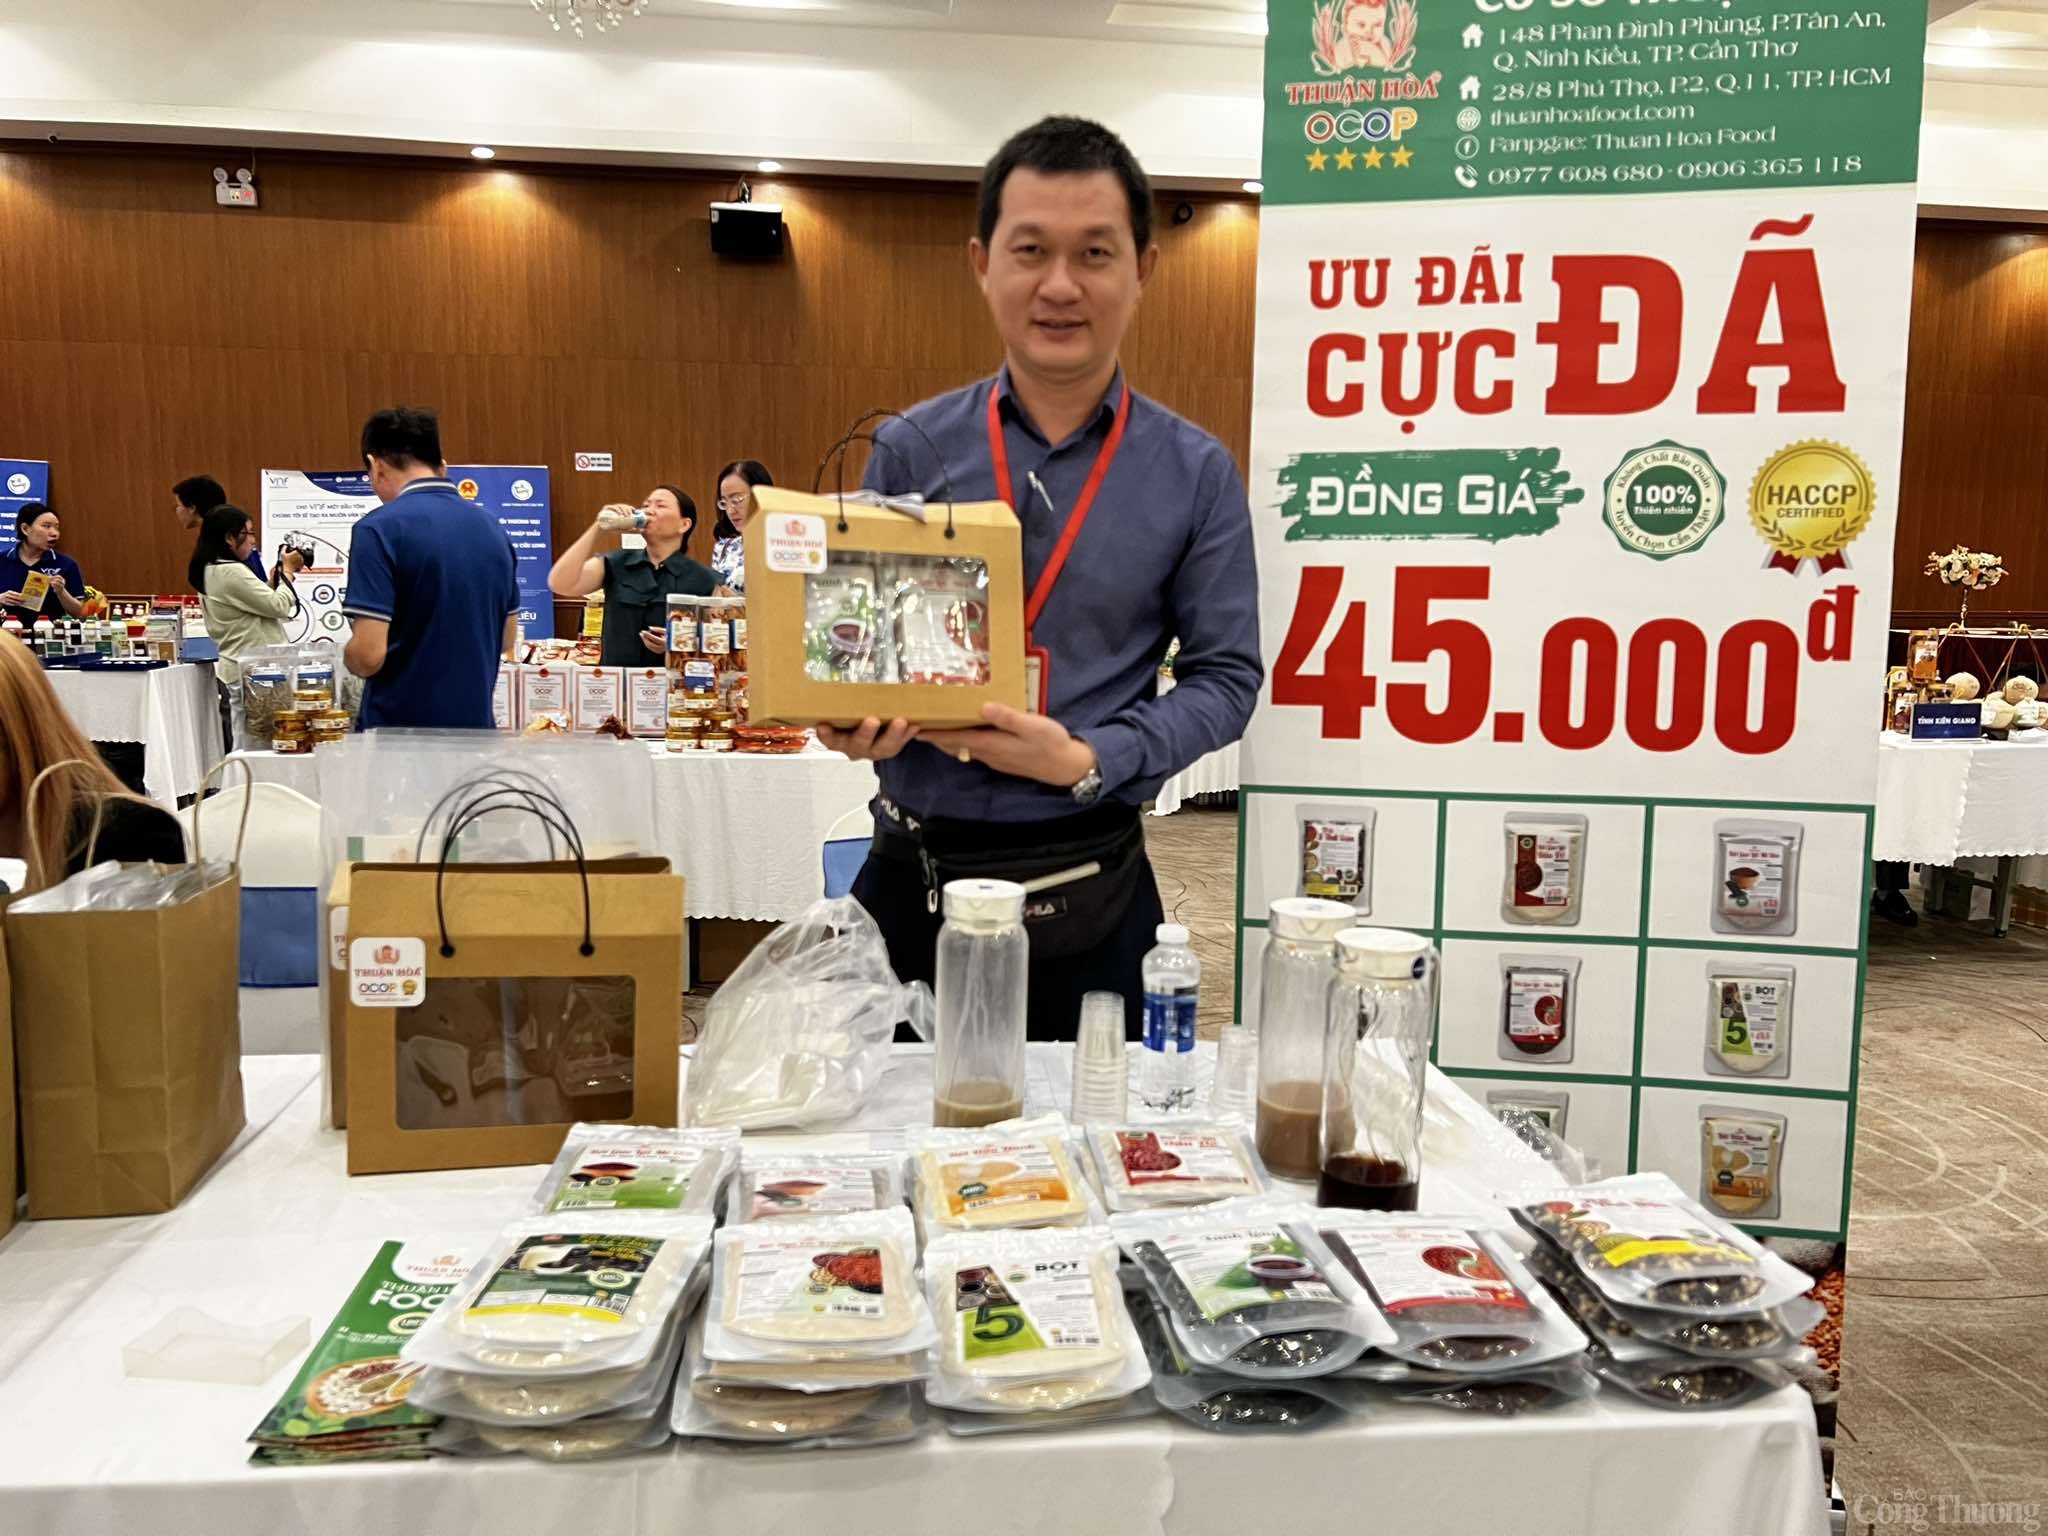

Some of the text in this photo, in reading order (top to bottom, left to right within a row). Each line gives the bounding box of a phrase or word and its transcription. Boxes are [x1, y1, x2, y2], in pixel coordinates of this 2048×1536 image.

[1500, 25, 1545, 45] 148
[1551, 22, 1612, 42] Phan
[1844, 10, 1887, 30] An,
[1525, 47, 1579, 69] Ninh
[1690, 38, 1739, 61] Cần
[1746, 38, 1799, 58] Thơ
[1285, 75, 1377, 108] THUẬN
[1492, 79, 1553, 101] 28/8
[1558, 75, 1605, 98] Phú
[1829, 66, 1891, 88] HCM
[1305, 106, 1418, 144] OCOP
[1490, 103, 1695, 128] thuanhoafood.com
[1593, 130, 1661, 151] Thuan
[1667, 128, 1712, 148] Hoa
[1717, 125, 1777, 146] Food
[1488, 165, 1553, 186] 0977
[1559, 163, 1608, 184] 608
[1613, 163, 1664, 183] 680
[1678, 159, 1746, 179] 0906
[1752, 157, 1804, 176] 365
[1814, 155, 1863, 174] 118
[1308, 243, 1525, 310] ƯU ĐÃI
[1306, 213, 1848, 435] CỰC ĐÃ
[1617, 460, 1643, 490] Không
[1643, 451, 1669, 467] Chất
[1672, 452, 1691, 467] Bảo
[1306, 463, 1444, 517] ĐỒNG
[1633, 484, 1698, 505] 100%
[1767, 484, 1858, 506] HACCP
[1633, 505, 1662, 515] Thiên
[1776, 507, 1846, 519] CERTIFIED
[1635, 535, 1666, 552] Chọn
[1690, 507, 1712, 535] Thận
[1952, 717, 1977, 725] GIANG
[1725, 1021, 1748, 1045] 5
[972, 1303, 1025, 1341] 5
